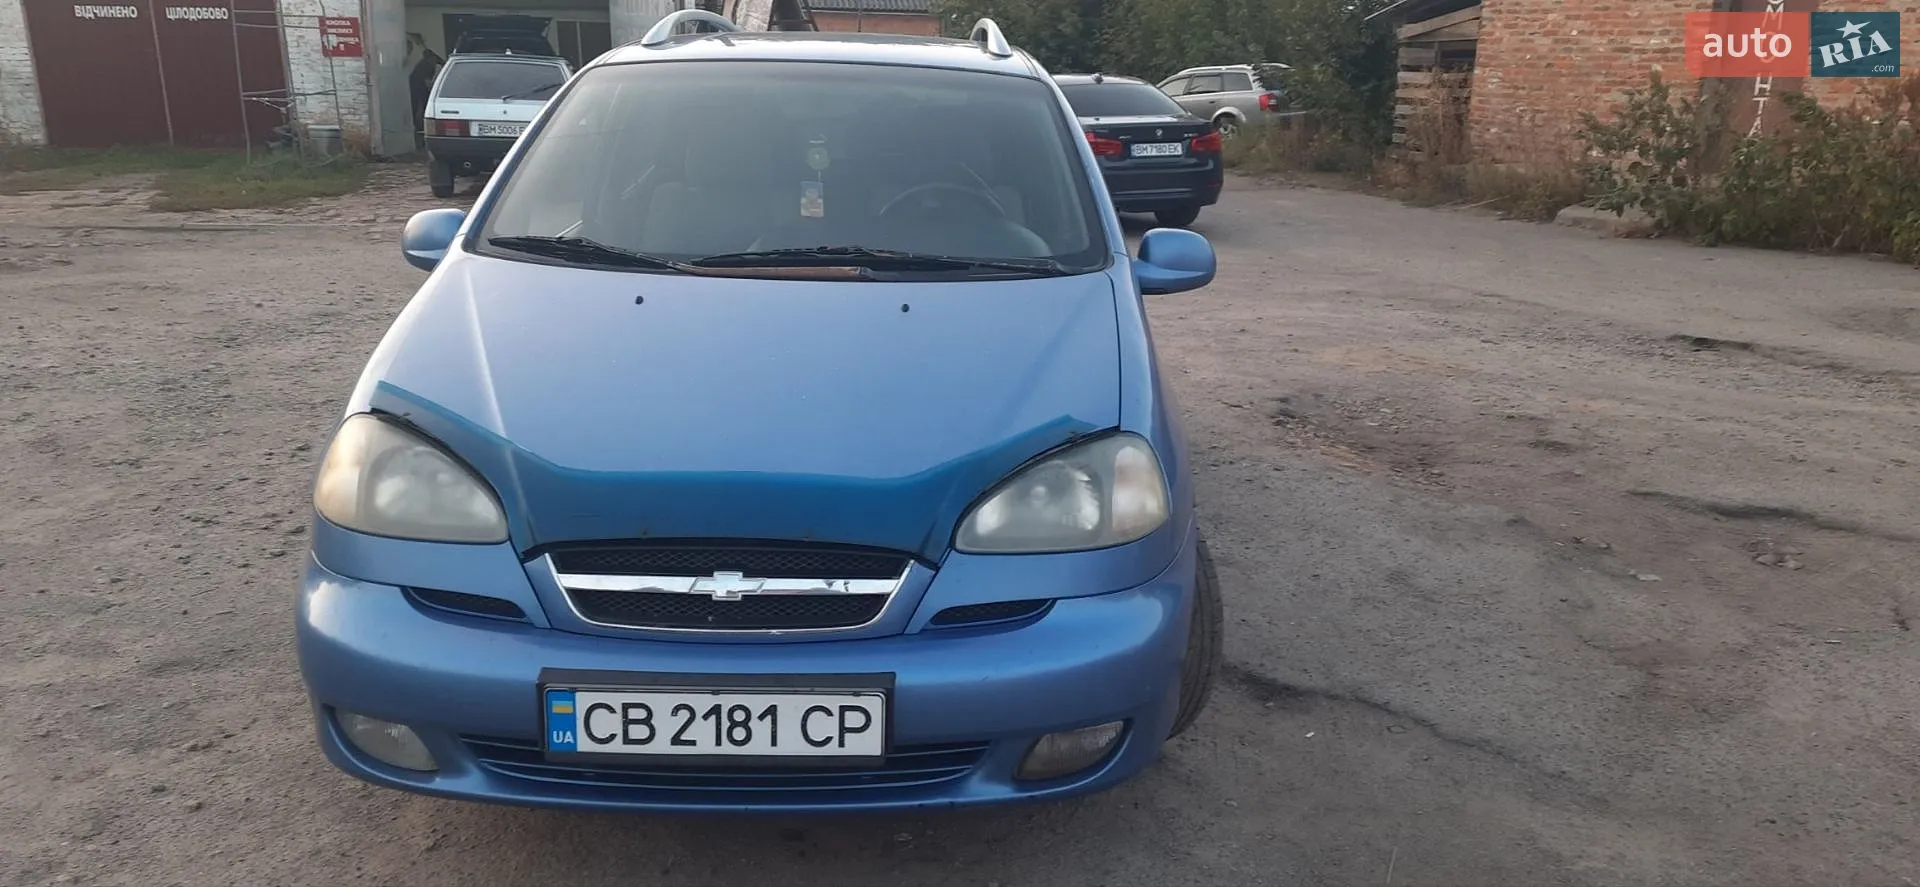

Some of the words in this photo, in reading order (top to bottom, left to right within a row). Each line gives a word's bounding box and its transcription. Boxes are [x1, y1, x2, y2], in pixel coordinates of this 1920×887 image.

[74, 5, 138, 19] ВІДЧИНЕНО
[165, 7, 229, 21] ЦІЛОДОБОВО
[583, 702, 657, 747] CB
[670, 703, 778, 748] 2181
[800, 705, 872, 748] CP
[552, 730, 575, 744] UA
